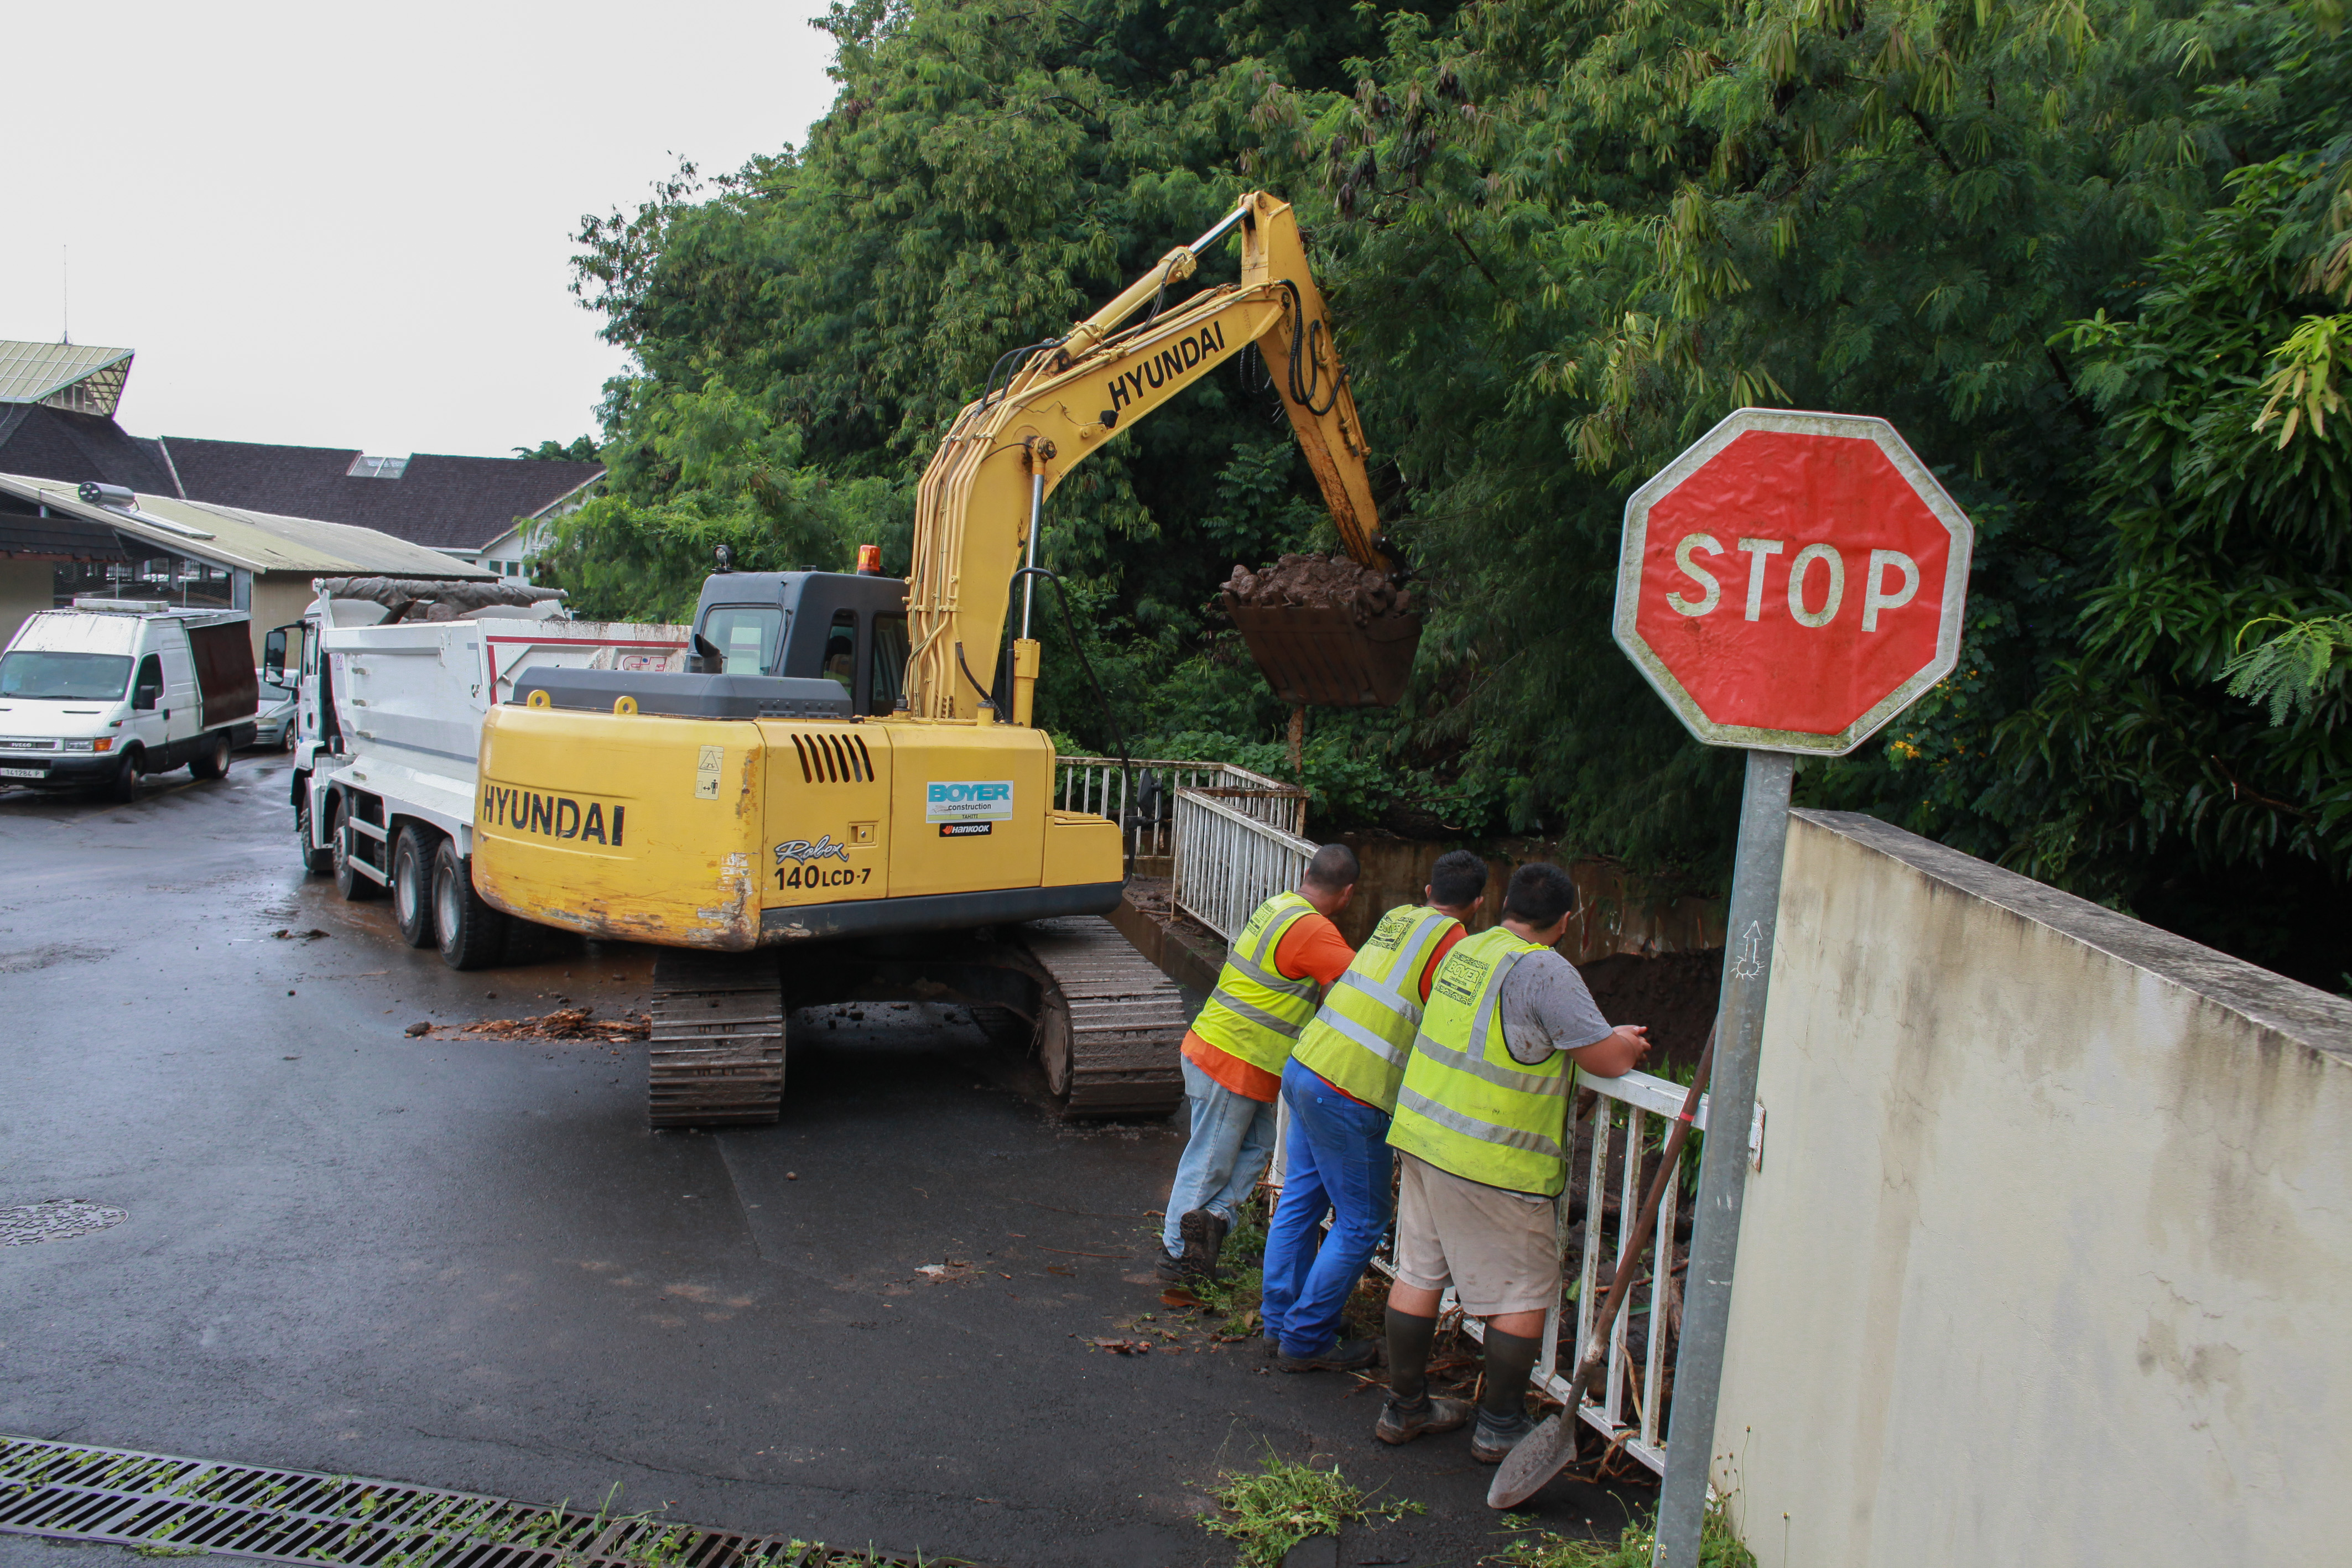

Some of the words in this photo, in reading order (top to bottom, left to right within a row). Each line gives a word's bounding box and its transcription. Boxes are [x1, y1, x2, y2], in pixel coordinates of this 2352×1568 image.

[1108, 320, 1225, 412] HYUNDAI
[1666, 533, 1919, 632] STOP
[483, 784, 625, 846] HYUNDAI
[928, 784, 1011, 802] BOYER
[774, 835, 849, 865] Robex
[1446, 960, 1480, 983] BOYER
